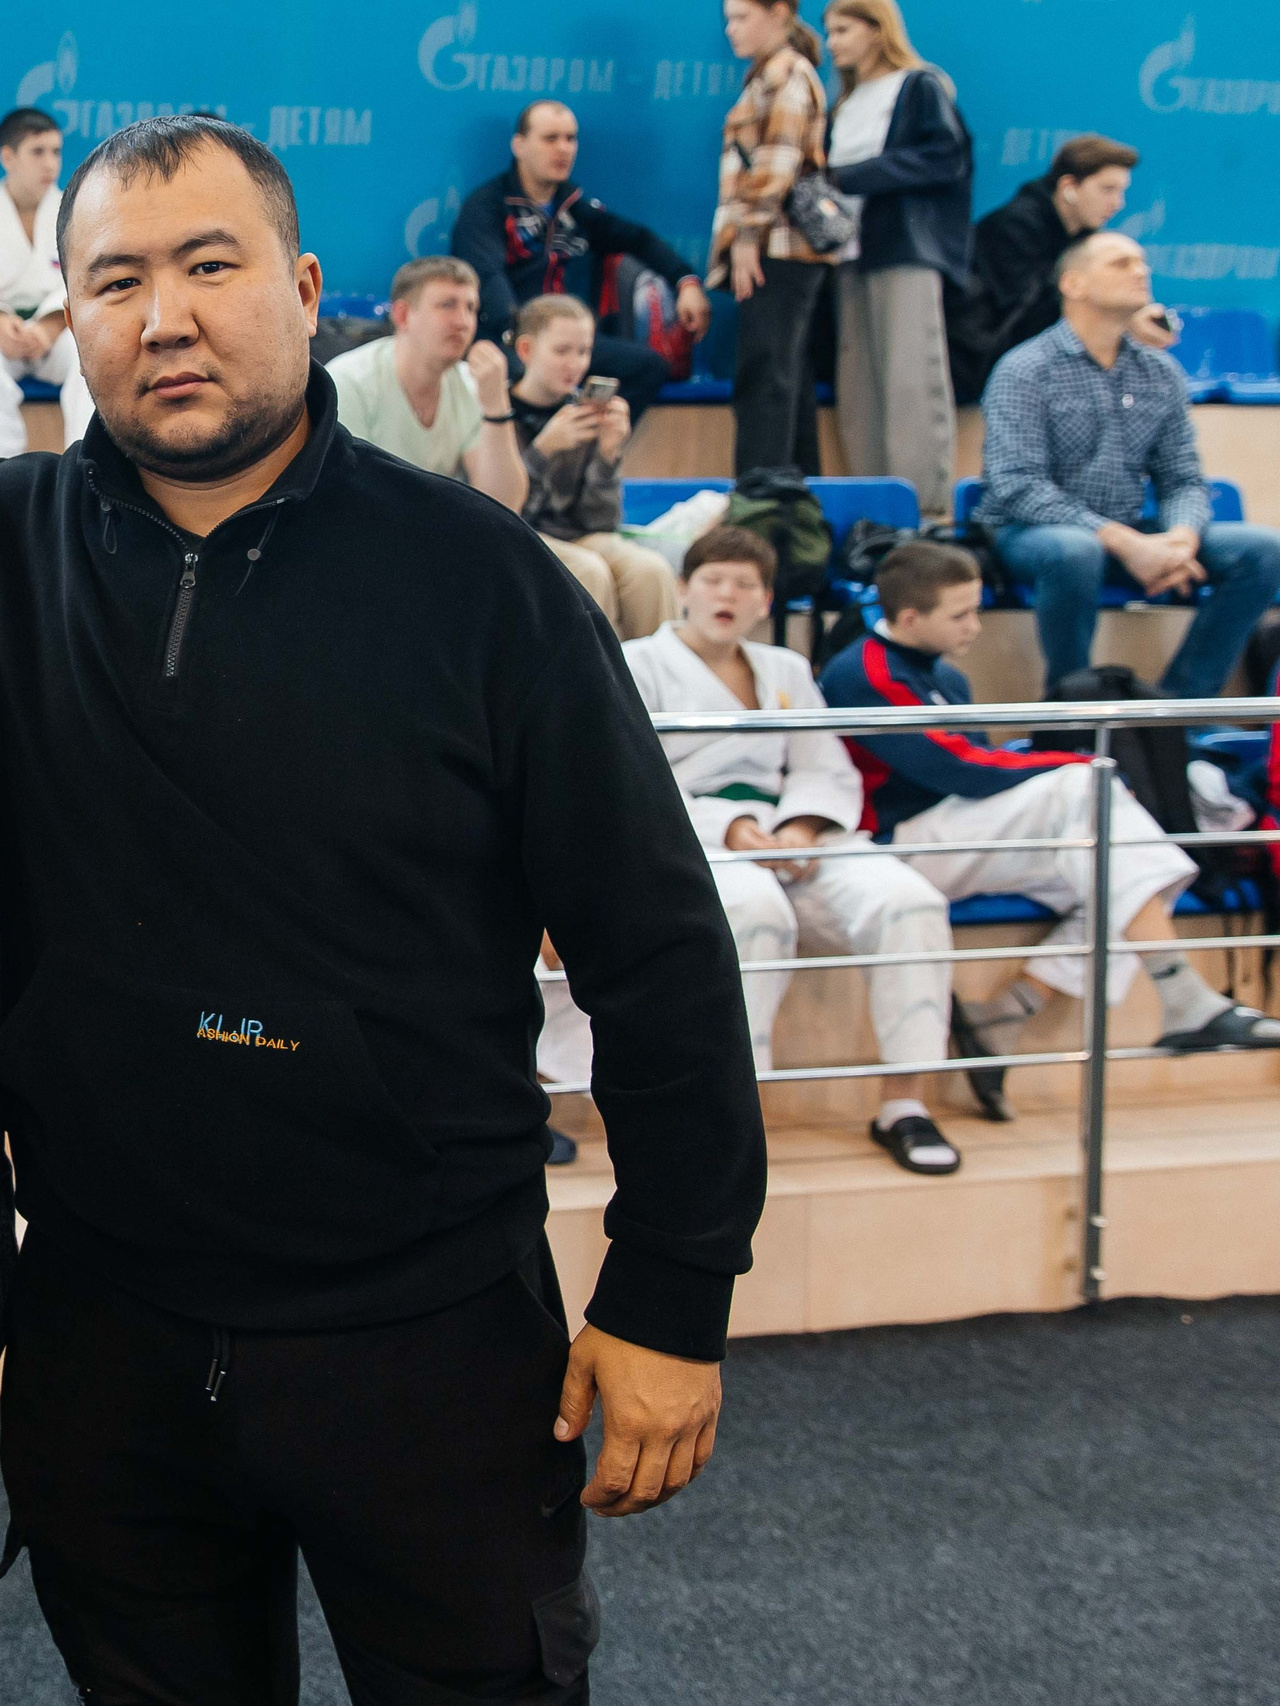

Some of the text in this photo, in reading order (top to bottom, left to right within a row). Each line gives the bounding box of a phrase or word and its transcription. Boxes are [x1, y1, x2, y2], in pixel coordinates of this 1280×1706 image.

[477, 54, 615, 92] ГАЗПРОМ
[267, 104, 373, 152] ДЕТЯМ
[255, 1036, 301, 1052] DAILY
